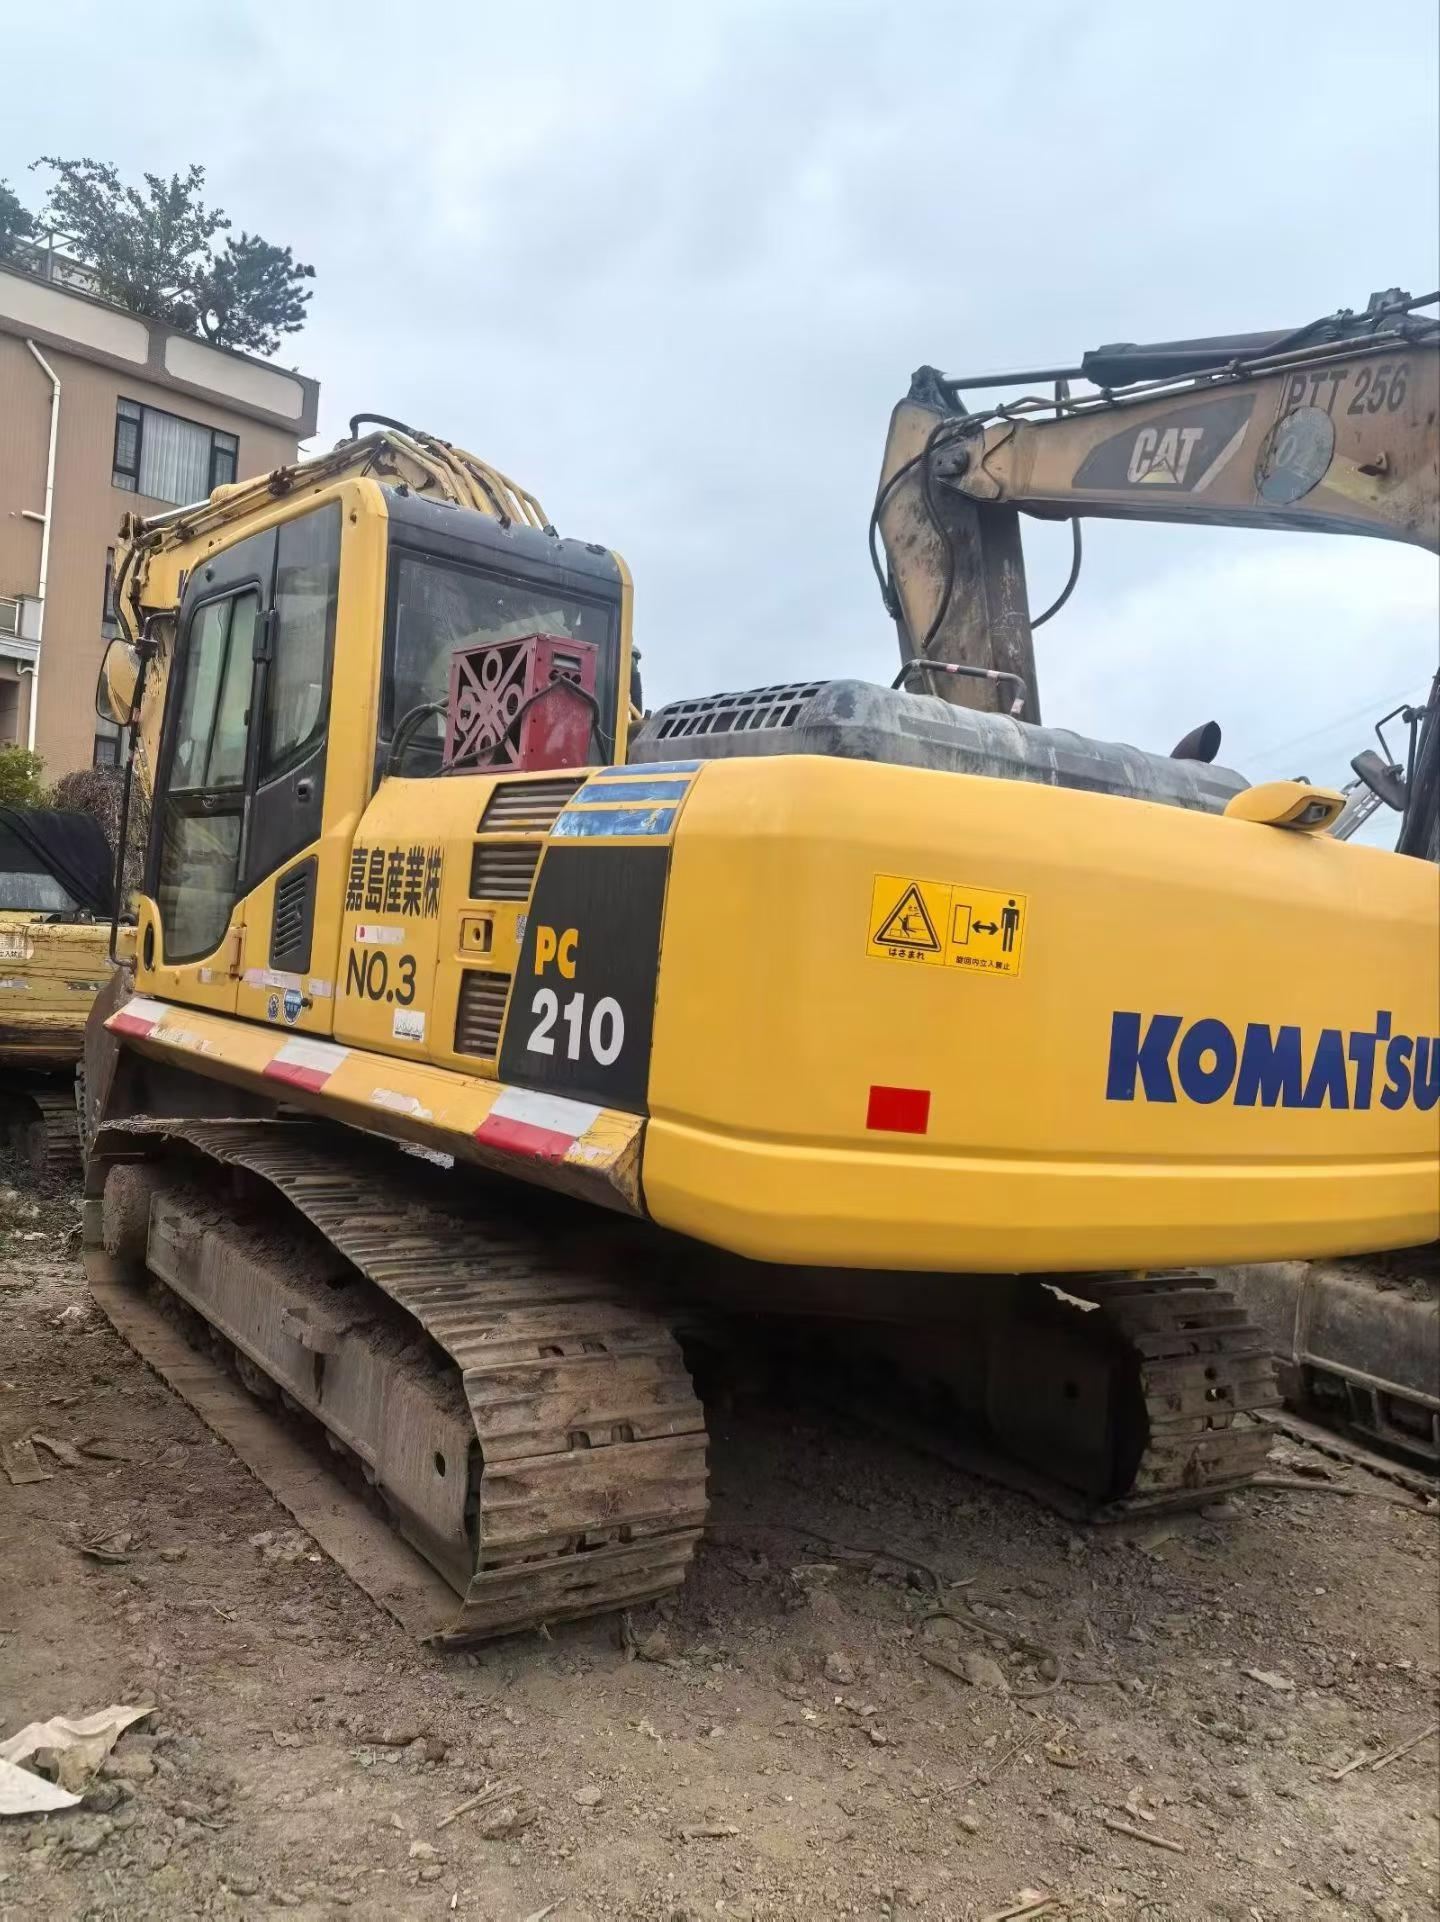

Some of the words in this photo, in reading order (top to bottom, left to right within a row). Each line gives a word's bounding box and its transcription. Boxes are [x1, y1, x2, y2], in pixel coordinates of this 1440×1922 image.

[1346, 362, 1410, 416] 256
[1126, 427, 1204, 484] CAT
[345, 947, 417, 1006] NO.3
[534, 925, 579, 979] PC
[888, 947, 925, 960] はさまれ
[526, 987, 625, 1066] 210
[1105, 1009, 1439, 1111] KOMATSU
